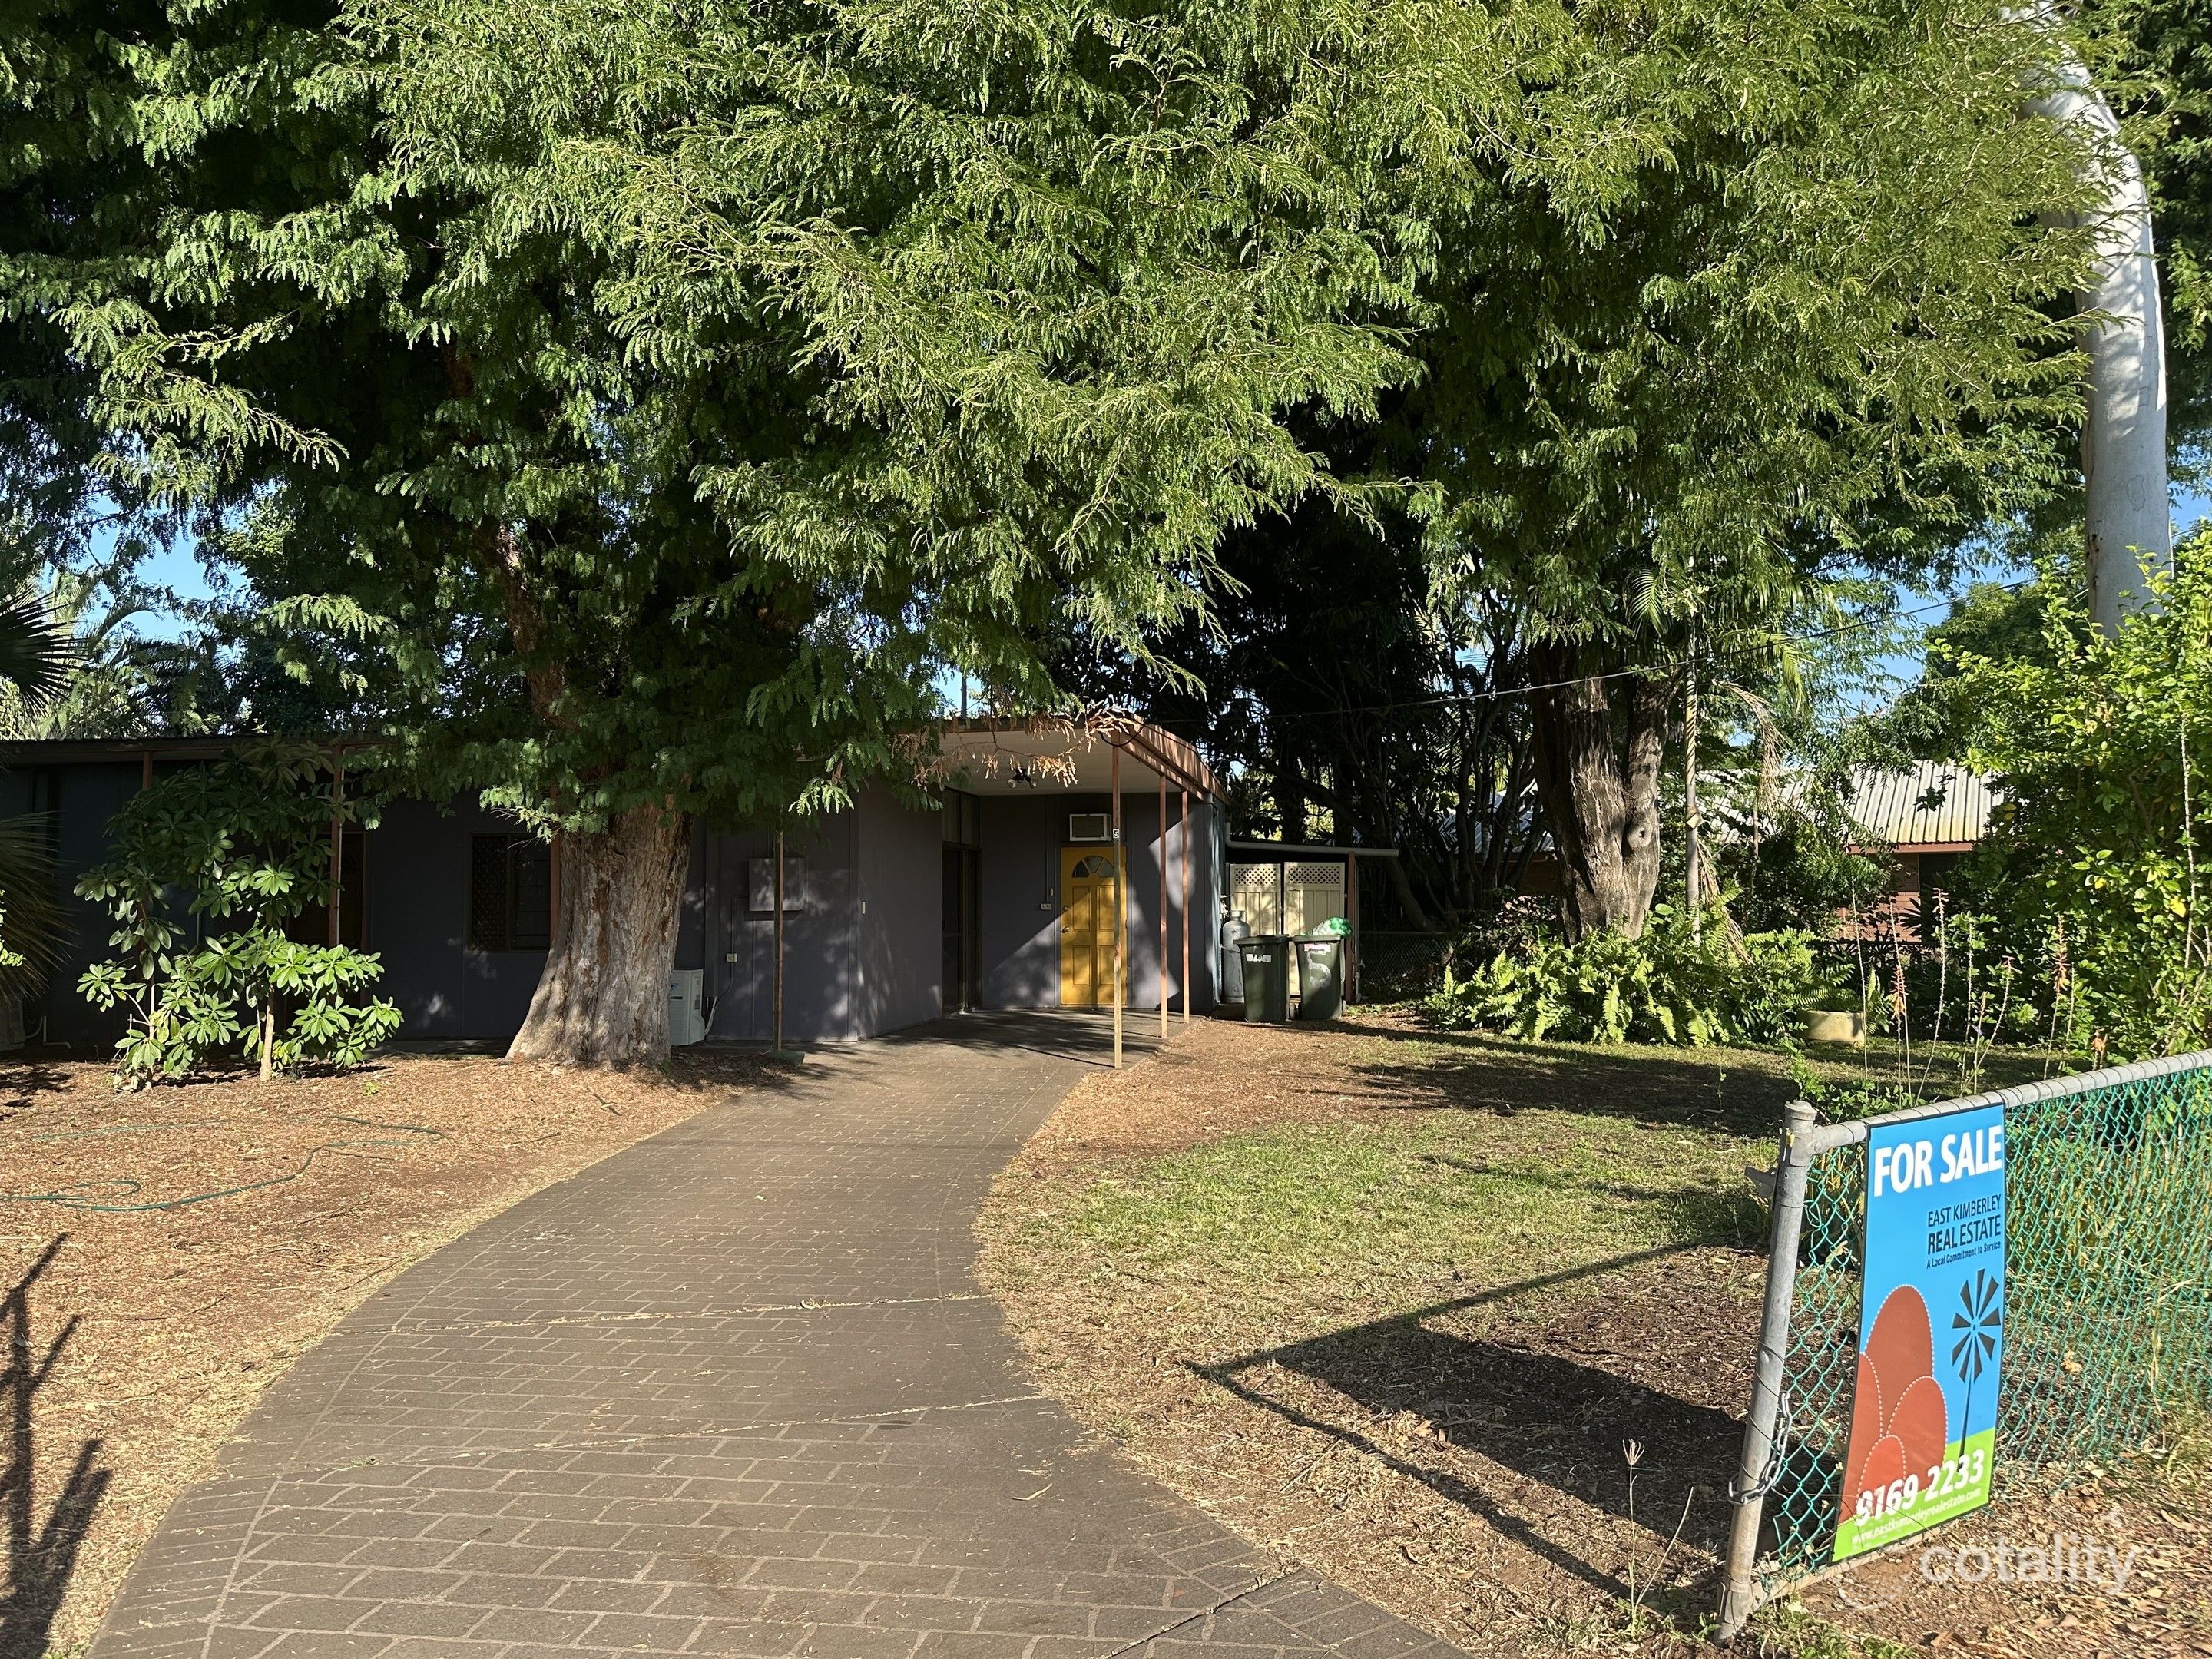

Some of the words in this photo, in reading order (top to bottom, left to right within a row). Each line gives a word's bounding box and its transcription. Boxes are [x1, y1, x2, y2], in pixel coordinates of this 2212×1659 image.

[1874, 1141, 1932, 1197] FOR
[1940, 1124, 2002, 1184] SALE
[1928, 1207, 1951, 1227] EAST
[1953, 1194, 2001, 1221] KIMBERLEY
[1926, 1260, 1931, 1269] A
[1932, 1255, 1945, 1267] Local
[1946, 1247, 1976, 1263] Commitment
[1978, 1245, 1983, 1254] to
[1984, 1241, 2001, 1253] Service
[1928, 1227, 1957, 1255] REAL
[1959, 1215, 2001, 1246] ESTATE
[1855, 1474, 1919, 1527] 9169
[1924, 1449, 1985, 1502] 2233
